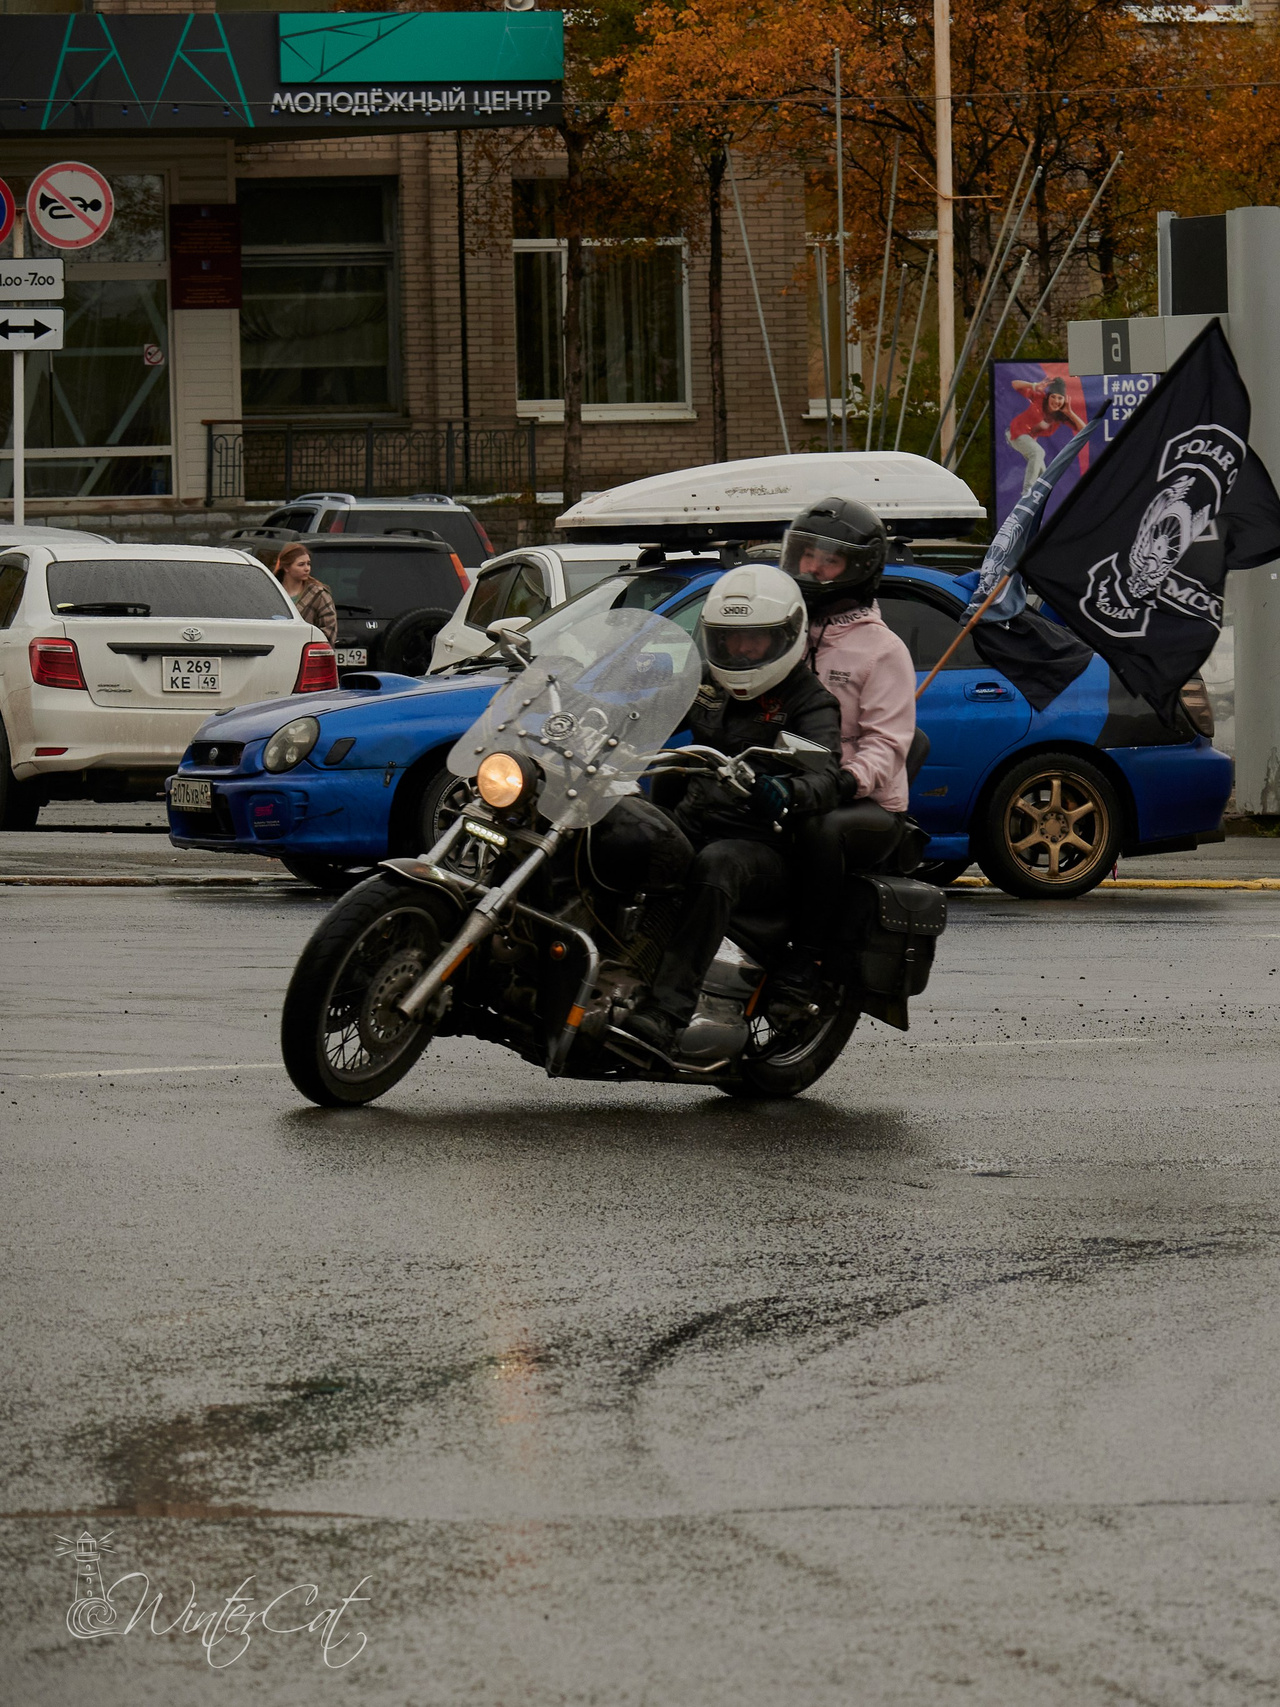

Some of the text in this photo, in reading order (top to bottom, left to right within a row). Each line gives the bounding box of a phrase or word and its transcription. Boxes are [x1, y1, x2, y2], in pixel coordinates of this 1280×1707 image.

[271, 87, 551, 117] МОЛОДЁЖНЫЙ ЦЕНТР
[1174, 438, 1236, 471] POLAR
[723, 606, 749, 615] SHOEI
[349, 650, 362, 660] 49
[186, 660, 212, 673] 269
[170, 676, 216, 689] КЕ 49
